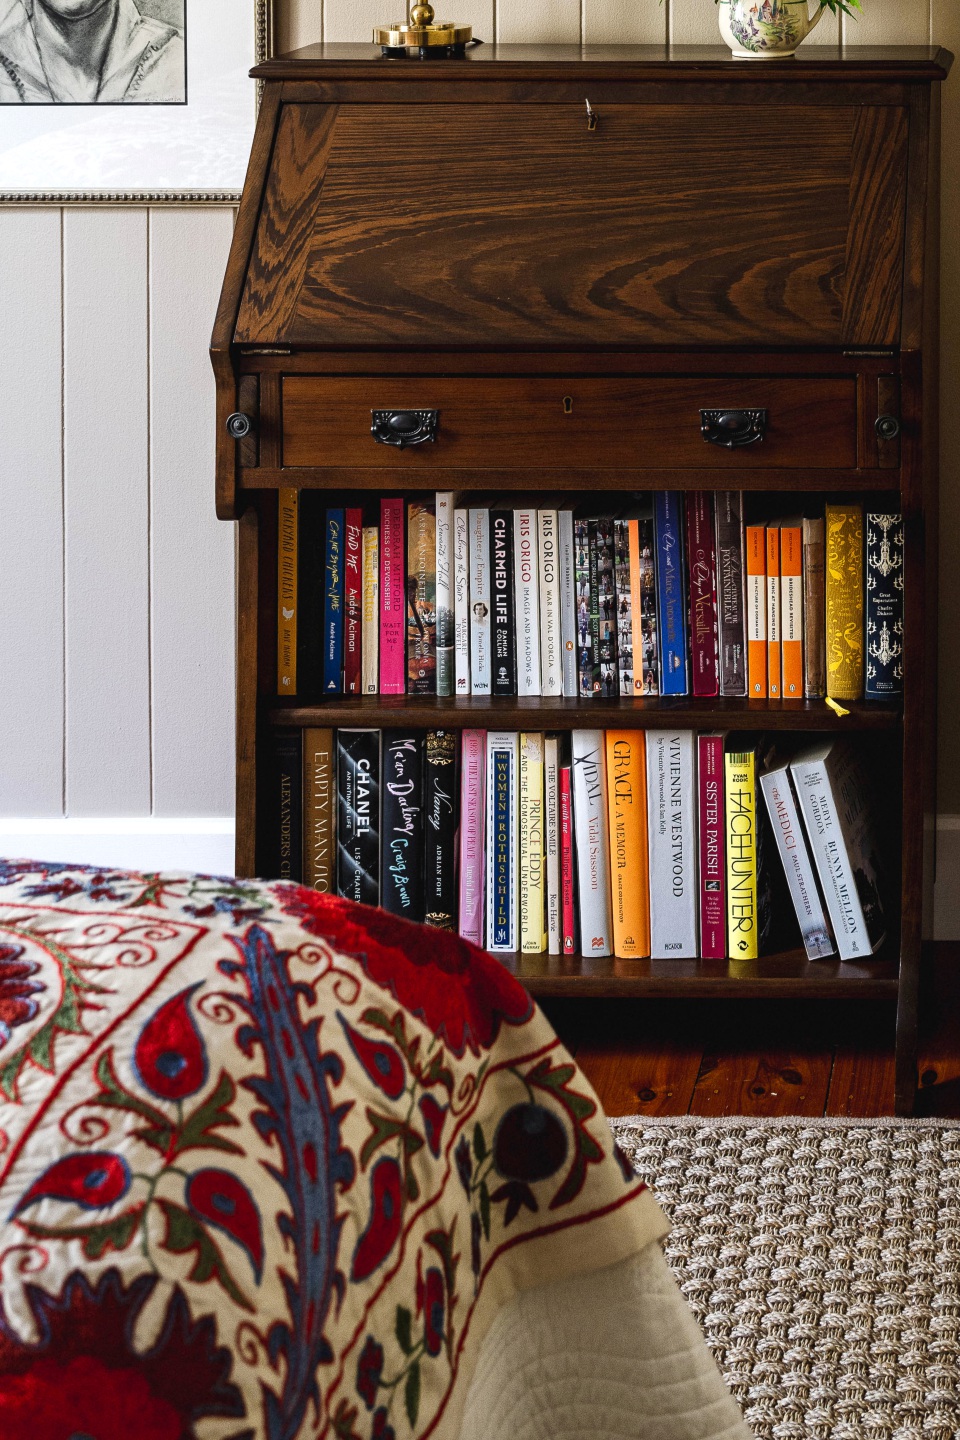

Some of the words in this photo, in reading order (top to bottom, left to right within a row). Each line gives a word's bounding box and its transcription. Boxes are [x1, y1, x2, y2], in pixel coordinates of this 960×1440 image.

[282, 507, 294, 552] BACKYARD
[393, 508, 401, 560] DEBORAH
[419, 506, 427, 538] MARIE
[455, 516, 466, 560] Climbing
[474, 512, 484, 552] Daughter
[520, 514, 530, 536] IRIS
[543, 515, 552, 537] IRIS
[347, 553, 358, 574] ME
[384, 547, 391, 557] OF
[494, 518, 506, 589] CHARMED
[520, 540, 531, 582] ORIGO
[543, 540, 554, 583] ORIGO
[282, 556, 294, 601] CHICKENS
[364, 535, 378, 622] Mountbatten
[393, 563, 401, 612] MITFORD
[419, 542, 427, 602] ANTOINETTE
[437, 560, 450, 591] Hall
[456, 576, 466, 602] Stairs
[475, 563, 485, 595] Empire
[665, 568, 674, 594] Marie
[720, 547, 733, 624] FONTAINEBLEAU
[349, 588, 359, 615] André
[496, 594, 508, 624] LIFE
[523, 587, 531, 615] IMAGES
[547, 609, 553, 617] IN
[694, 594, 711, 644] Versailles
[732, 615, 738, 624] DE
[348, 618, 358, 652] Aciman
[388, 739, 416, 778] Ma'am
[469, 739, 477, 757] 1939:
[314, 750, 329, 812] EMPTY
[468, 760, 477, 776] THE
[468, 777, 477, 795] LAST
[496, 763, 507, 811] WOMEN
[548, 764, 556, 782] THE
[574, 748, 602, 806] VIDAL
[613, 740, 633, 806] GRACE
[669, 737, 681, 807] VIVIENNE
[357, 758, 370, 837] CHANEL
[387, 779, 420, 836] Darling
[429, 778, 452, 830] Nancy
[467, 797, 476, 823] SEASON
[548, 785, 556, 827] VOLTAIRE
[562, 792, 570, 803] lie
[706, 781, 718, 826] SISTER
[772, 787, 782, 801] The
[819, 795, 833, 829] MERYL
[281, 773, 290, 857] ALEXANDER'S
[467, 825, 476, 833] OF
[521, 796, 529, 860] HOMOSEXUAL
[529, 799, 541, 846] PRINCE
[562, 822, 568, 834] me
[588, 816, 599, 844] Vidal
[658, 820, 666, 835] Kelly
[775, 799, 796, 850] MEDICI
[809, 794, 825, 834] GORDON
[389, 838, 409, 873] Craig
[466, 835, 476, 859] PEACE
[563, 847, 571, 878] Philippe
[616, 822, 626, 869] MEMOIR
[671, 812, 683, 897] WESTWOOD
[707, 829, 718, 874] PARISH
[730, 789, 753, 932] FACEHUNTER
[791, 854, 800, 873] PAUL
[496, 823, 507, 925] ROTHSCHILD
[529, 853, 541, 889] EDDY
[590, 848, 600, 890] Sassoon
[827, 841, 845, 880] BUNNY
[839, 884, 858, 934] MELLON
[392, 874, 410, 907] Brown
[465, 888, 475, 916] Lambert
[521, 866, 529, 933] UNDERWORLD
[550, 894, 558, 908] Ron
[796, 874, 812, 916] STRATHERN
[550, 910, 558, 932] Harvie
